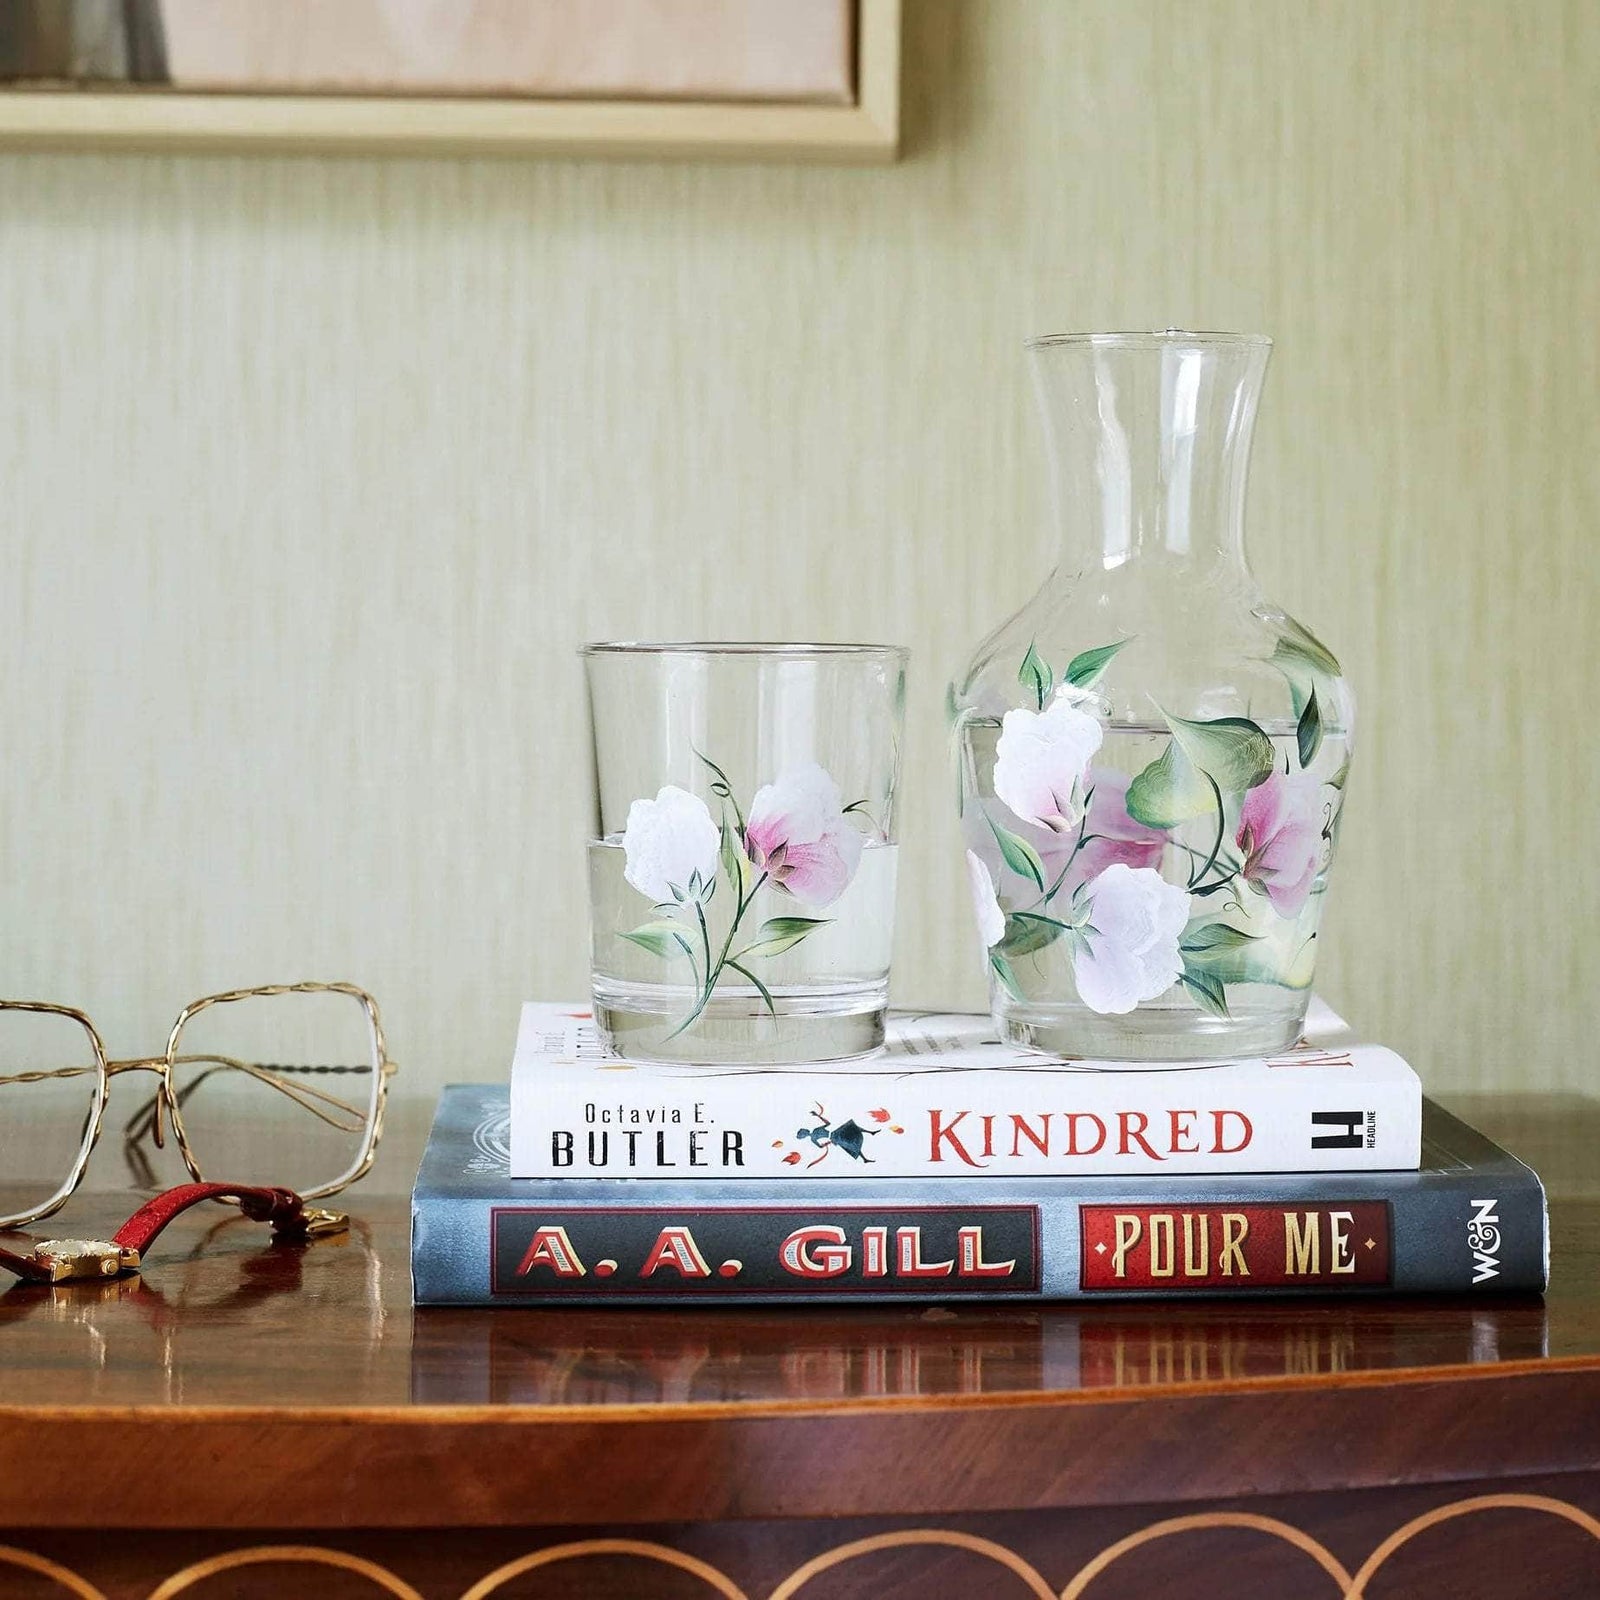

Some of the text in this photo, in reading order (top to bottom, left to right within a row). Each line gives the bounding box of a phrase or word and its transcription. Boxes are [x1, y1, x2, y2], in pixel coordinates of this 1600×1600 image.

[585, 1102, 715, 1124] Octavia E.
[1310, 1110, 1364, 1150] H
[1366, 1110, 1377, 1149] HEADLINE
[551, 1130, 745, 1167] BUTLER
[928, 1109, 1254, 1169] KINDRED
[516, 1225, 1017, 1278] A. A. GILL
[1110, 1210, 1357, 1278] POUR ME
[1467, 1199, 1502, 1284] W&N
